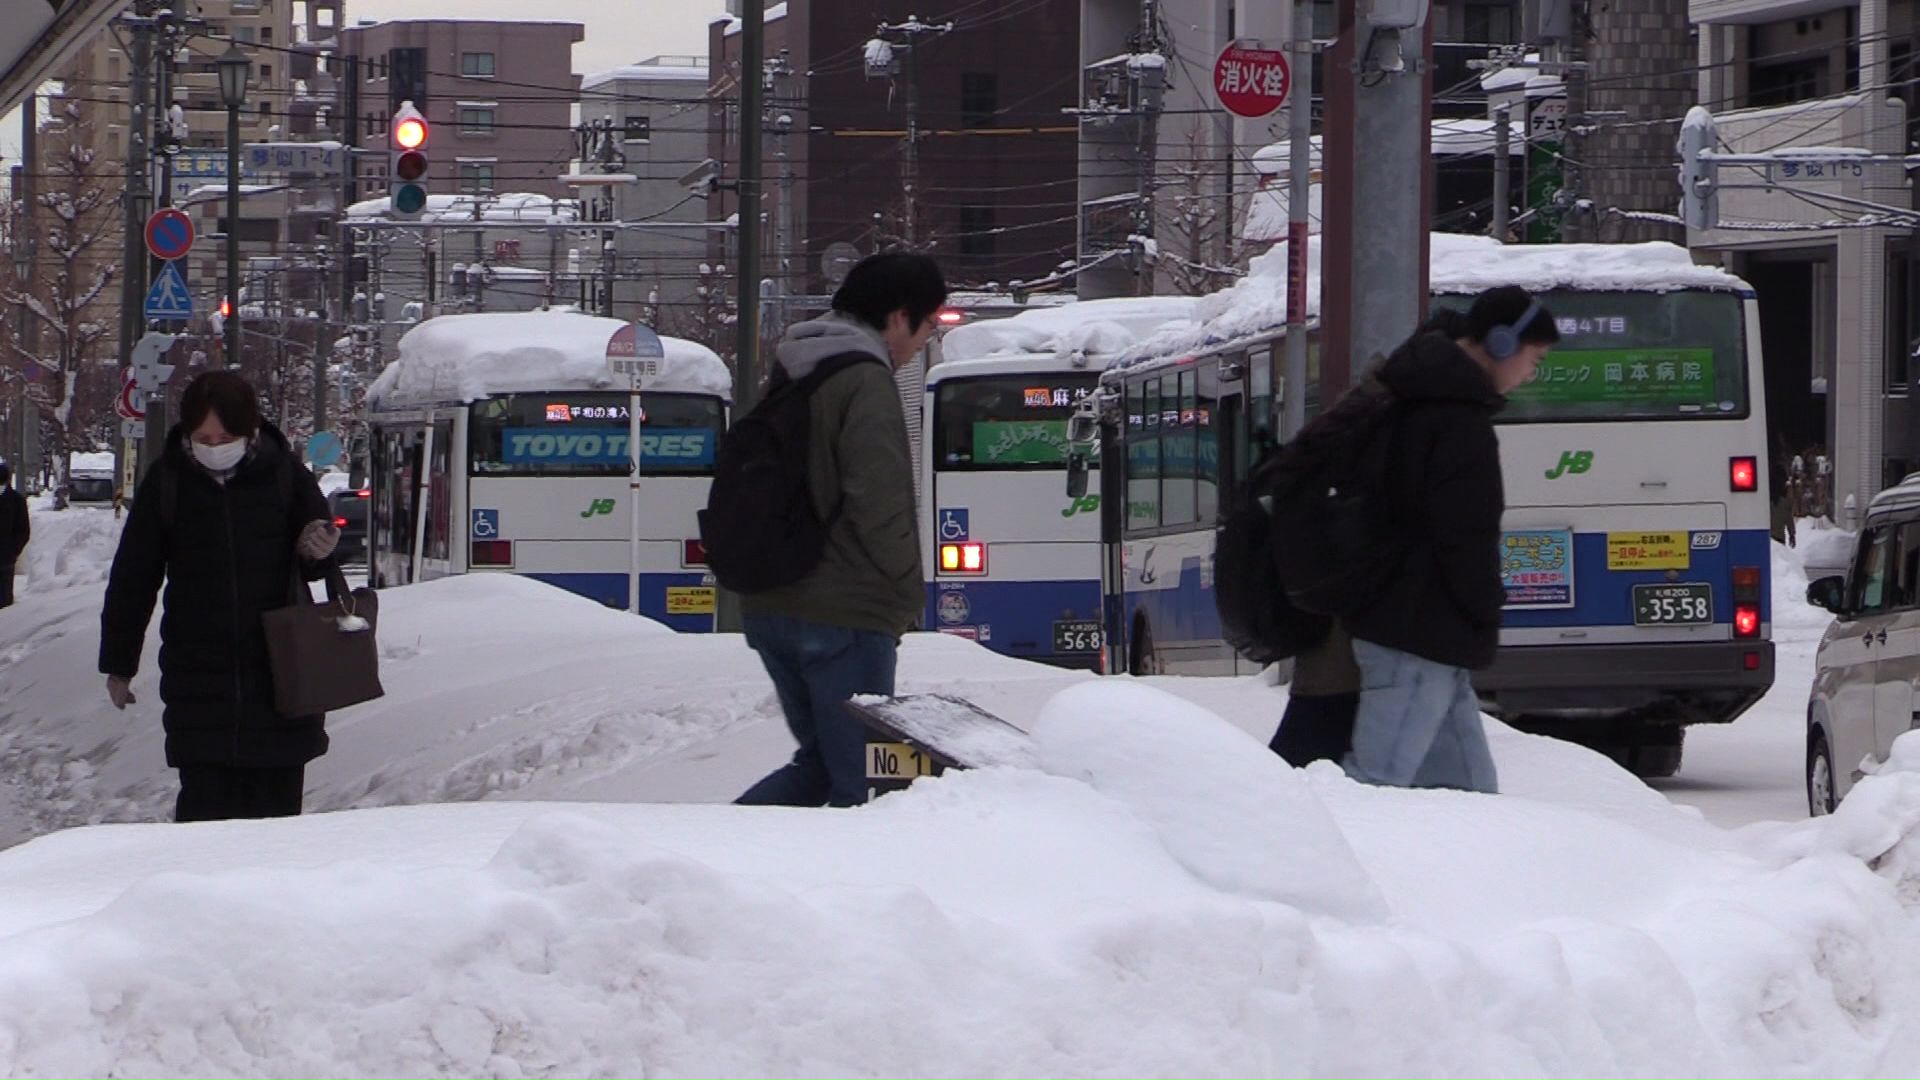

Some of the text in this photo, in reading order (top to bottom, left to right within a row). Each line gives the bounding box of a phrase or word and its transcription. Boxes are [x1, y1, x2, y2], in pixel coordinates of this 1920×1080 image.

[1219, 60, 1283, 96] 消火栓
[1604, 362, 1702, 382] 岡本病院
[571, 405, 646, 419] 平和の滝入
[511, 434, 601, 457] TOYO
[1649, 597, 1708, 620] 35-58
[874, 746, 922, 776] No. 1
